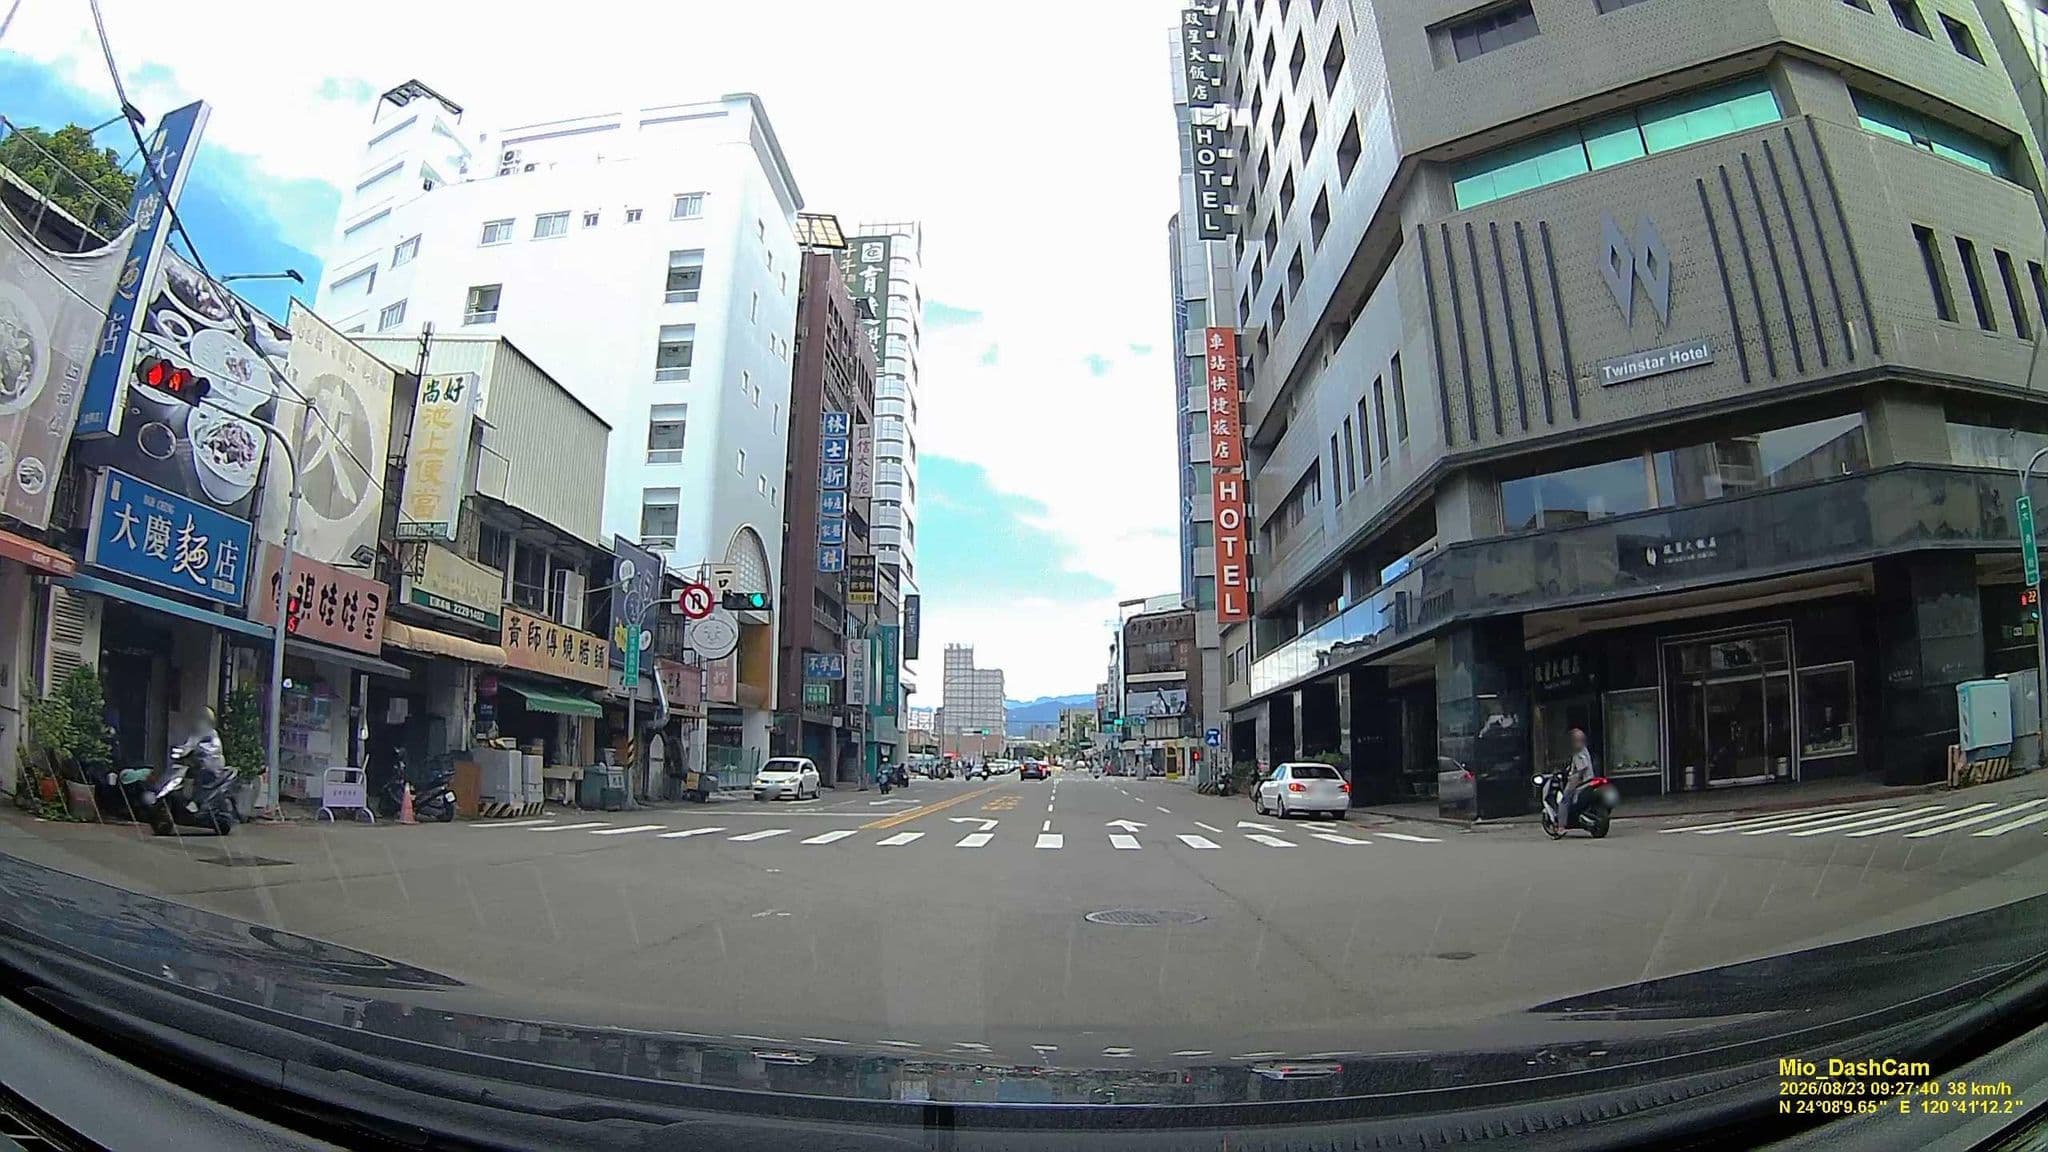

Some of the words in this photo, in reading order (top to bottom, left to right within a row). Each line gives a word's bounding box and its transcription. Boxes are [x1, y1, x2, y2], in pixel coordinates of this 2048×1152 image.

[1196, 128, 1220, 231] HOTEL
[422, 376, 465, 405] 尚好
[1209, 333, 1231, 460] 車站快捷旅店
[1602, 355, 1665, 379] Twinstar
[1668, 344, 1708, 364] Hotel
[110, 503, 240, 585] 大慶麵店
[1219, 480, 1241, 615] HOTEL
